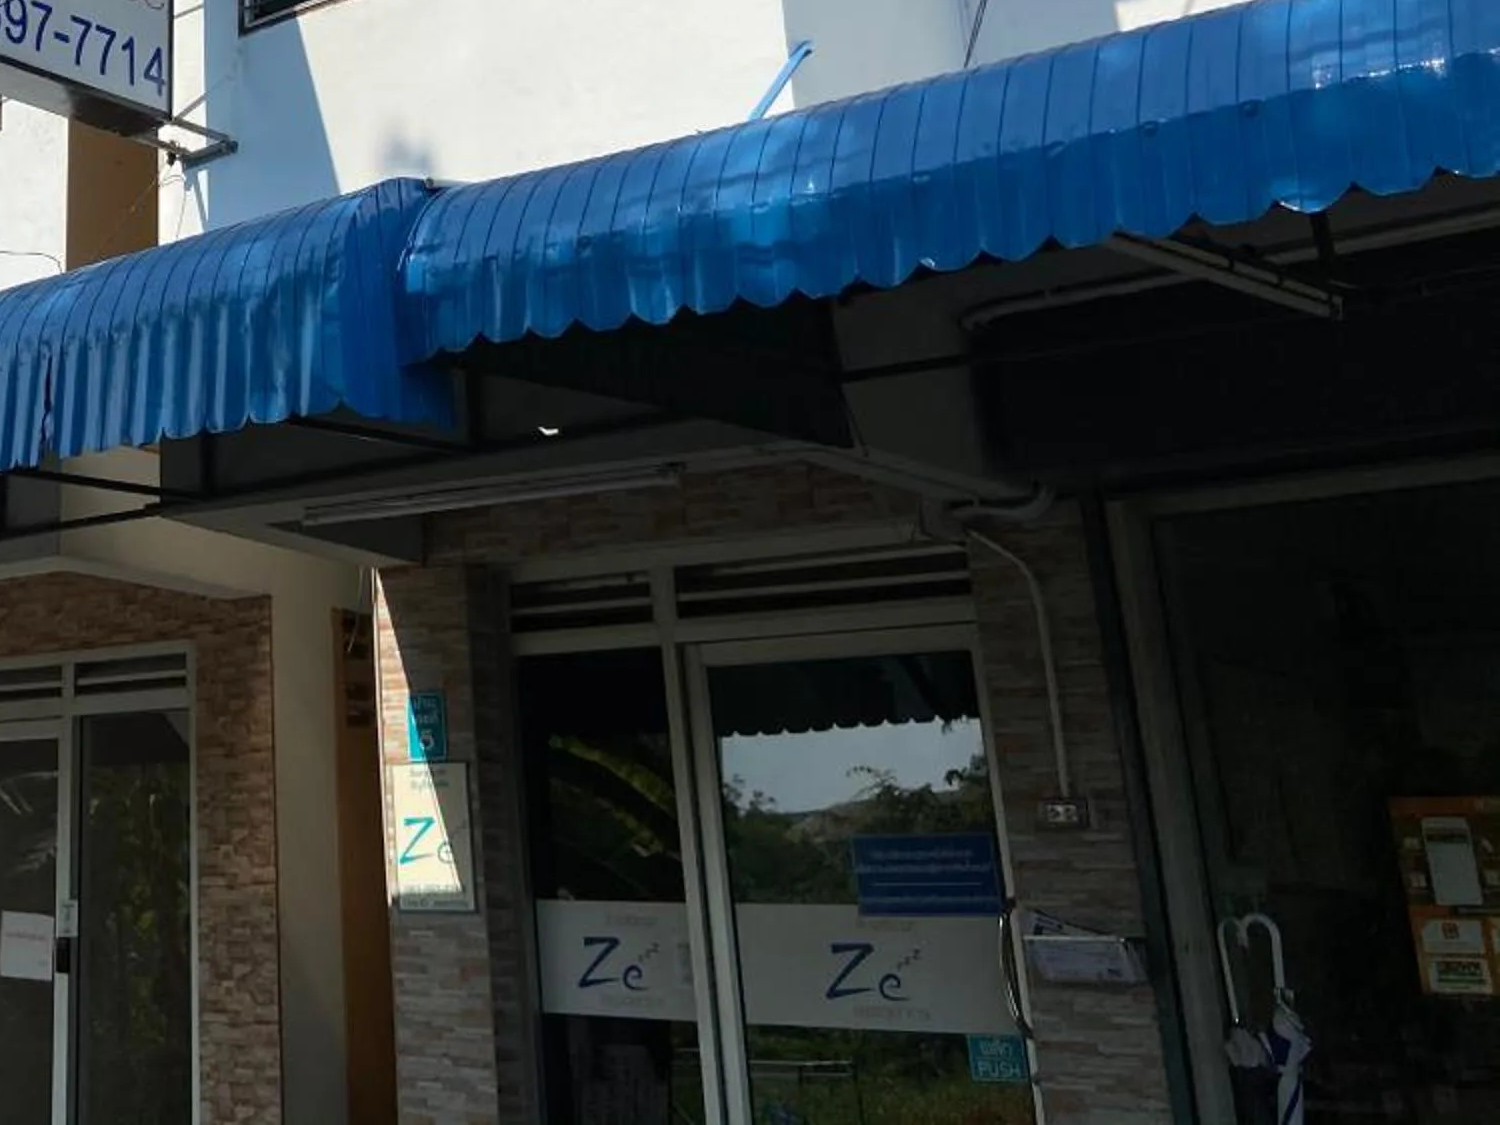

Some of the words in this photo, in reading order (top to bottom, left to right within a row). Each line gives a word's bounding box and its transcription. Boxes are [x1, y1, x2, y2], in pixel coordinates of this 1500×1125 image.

[579, 936, 650, 990] Ze
[825, 943, 911, 1001] Ze
[977, 1059, 1022, 1078] PUSH
